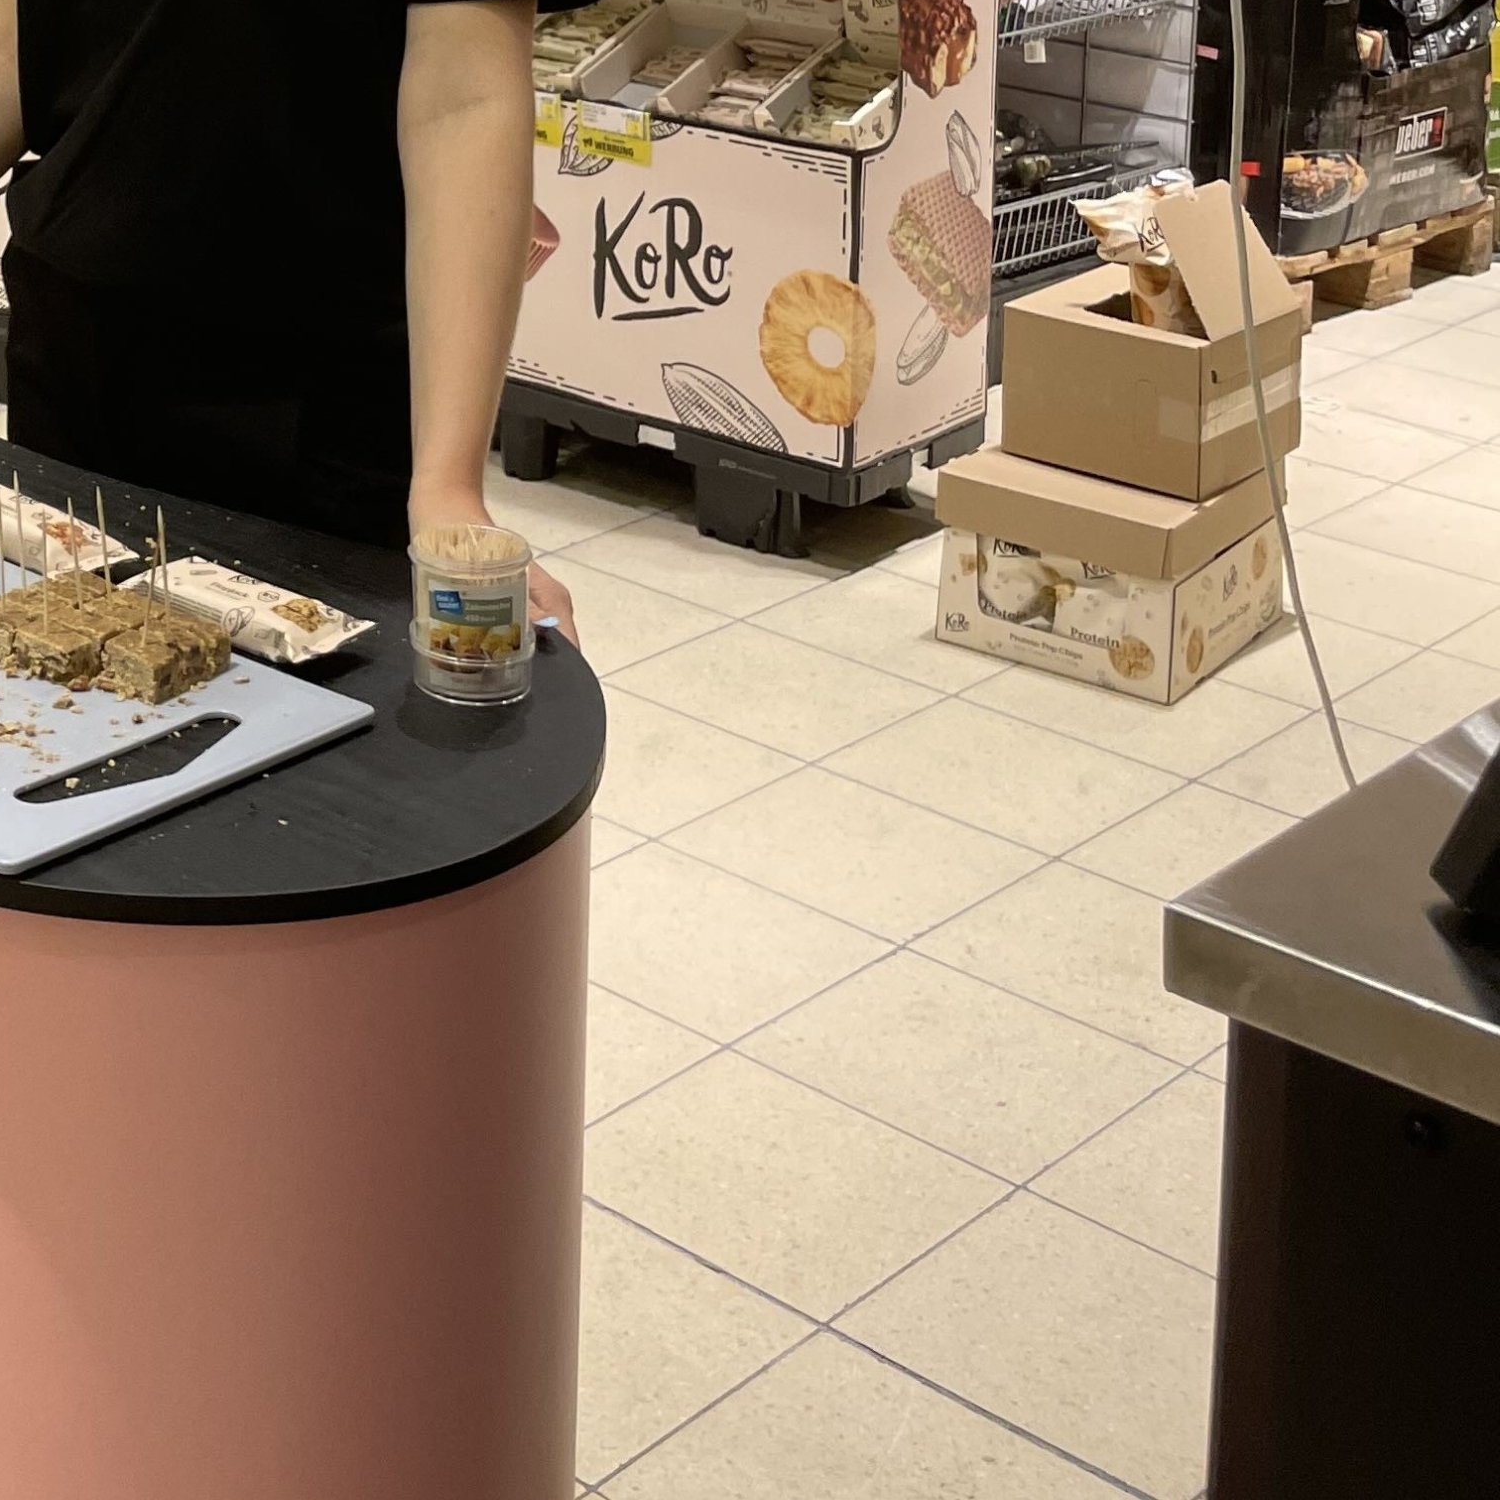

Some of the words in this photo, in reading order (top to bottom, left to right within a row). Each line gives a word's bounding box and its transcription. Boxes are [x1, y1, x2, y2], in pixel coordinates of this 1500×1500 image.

[1395, 117, 1433, 155] weber
[593, 139, 635, 159] WERBUNG
[593, 190, 733, 321] KoRo
[944, 612, 970, 632] KoRo
[1069, 626, 1120, 649] Protein
